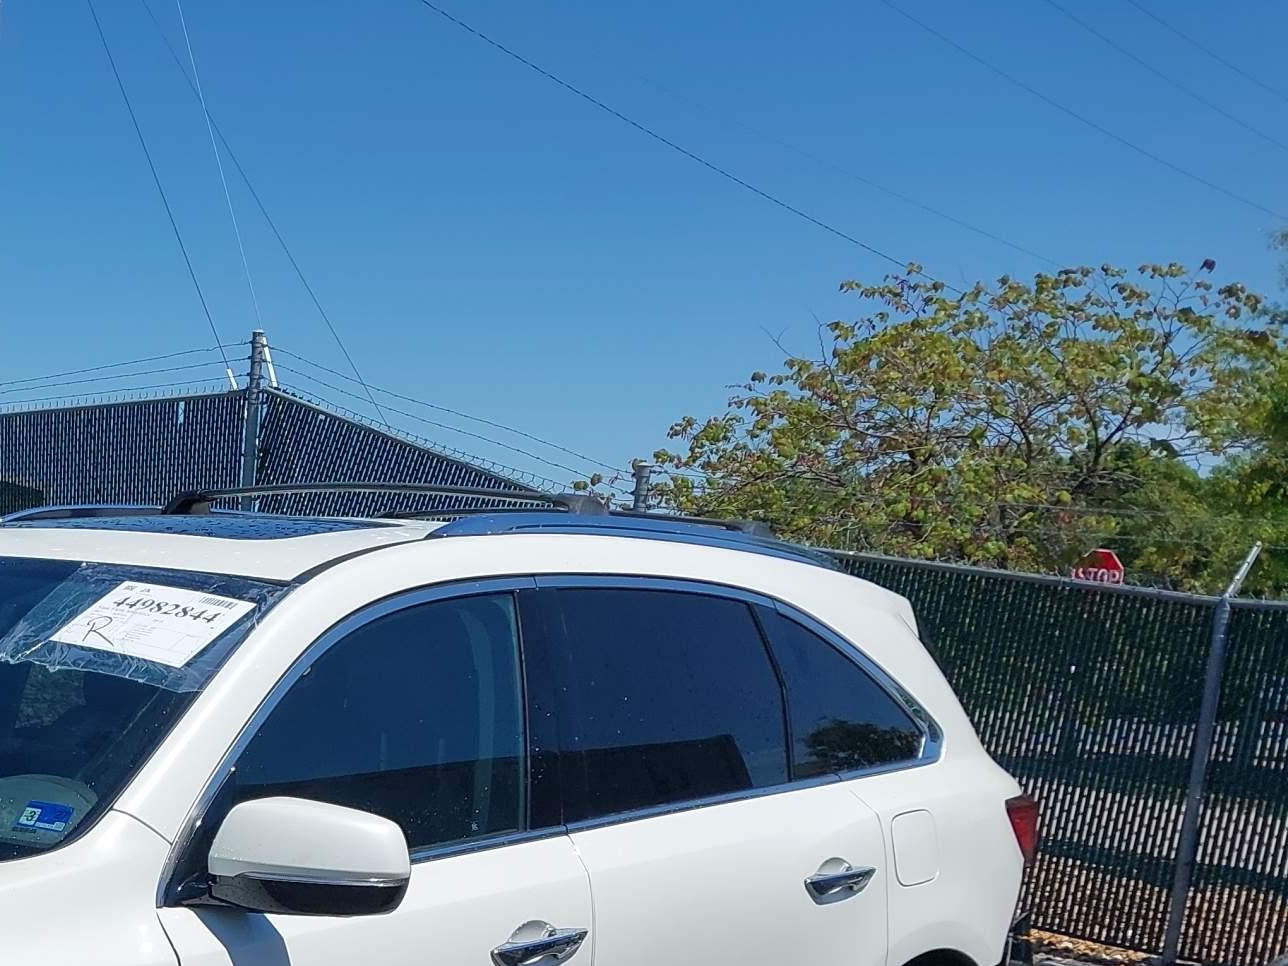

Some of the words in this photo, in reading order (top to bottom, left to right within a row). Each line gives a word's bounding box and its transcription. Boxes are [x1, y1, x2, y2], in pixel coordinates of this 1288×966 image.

[1077, 567, 1120, 583] STOP
[113, 596, 220, 623] 44982844
[82, 615, 114, 646] R
